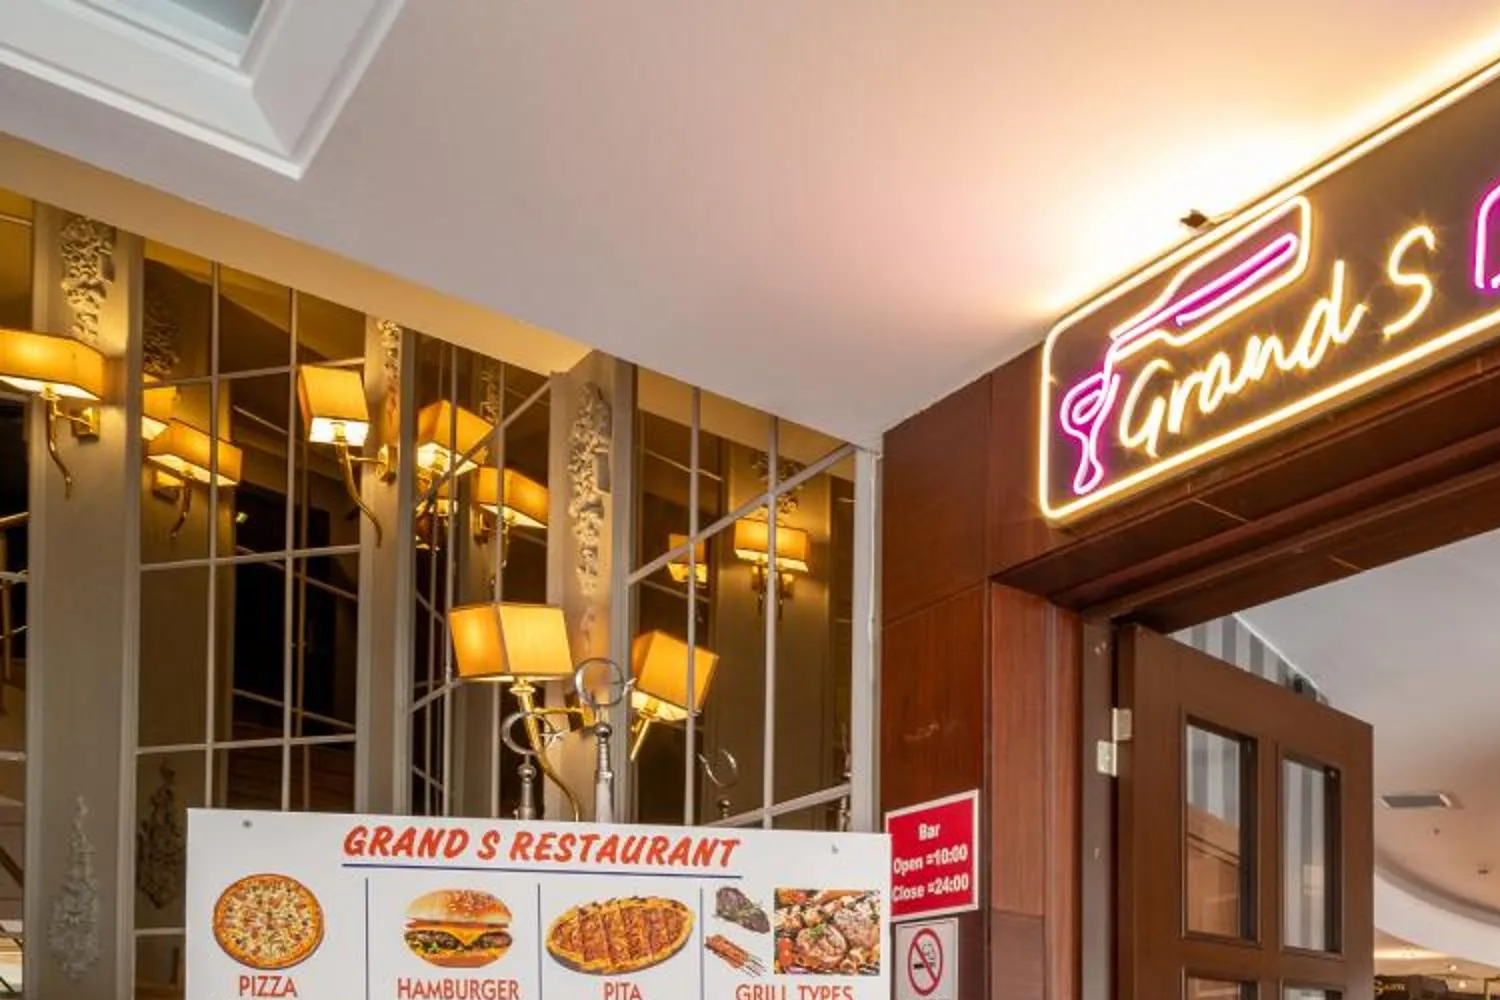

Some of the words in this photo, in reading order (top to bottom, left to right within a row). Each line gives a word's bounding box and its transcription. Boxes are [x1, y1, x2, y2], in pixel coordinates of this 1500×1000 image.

[1117, 260, 1370, 459] Grand
[1381, 225, 1439, 342] S
[918, 823, 941, 841] Bar
[344, 826, 469, 858] GRAND
[477, 830, 500, 860] S
[509, 832, 740, 866] RESTAURANT
[894, 855, 923, 876] Open
[893, 884, 924, 902] Close
[239, 975, 297, 998] PIZZA
[398, 979, 519, 1000] HAMBURGER
